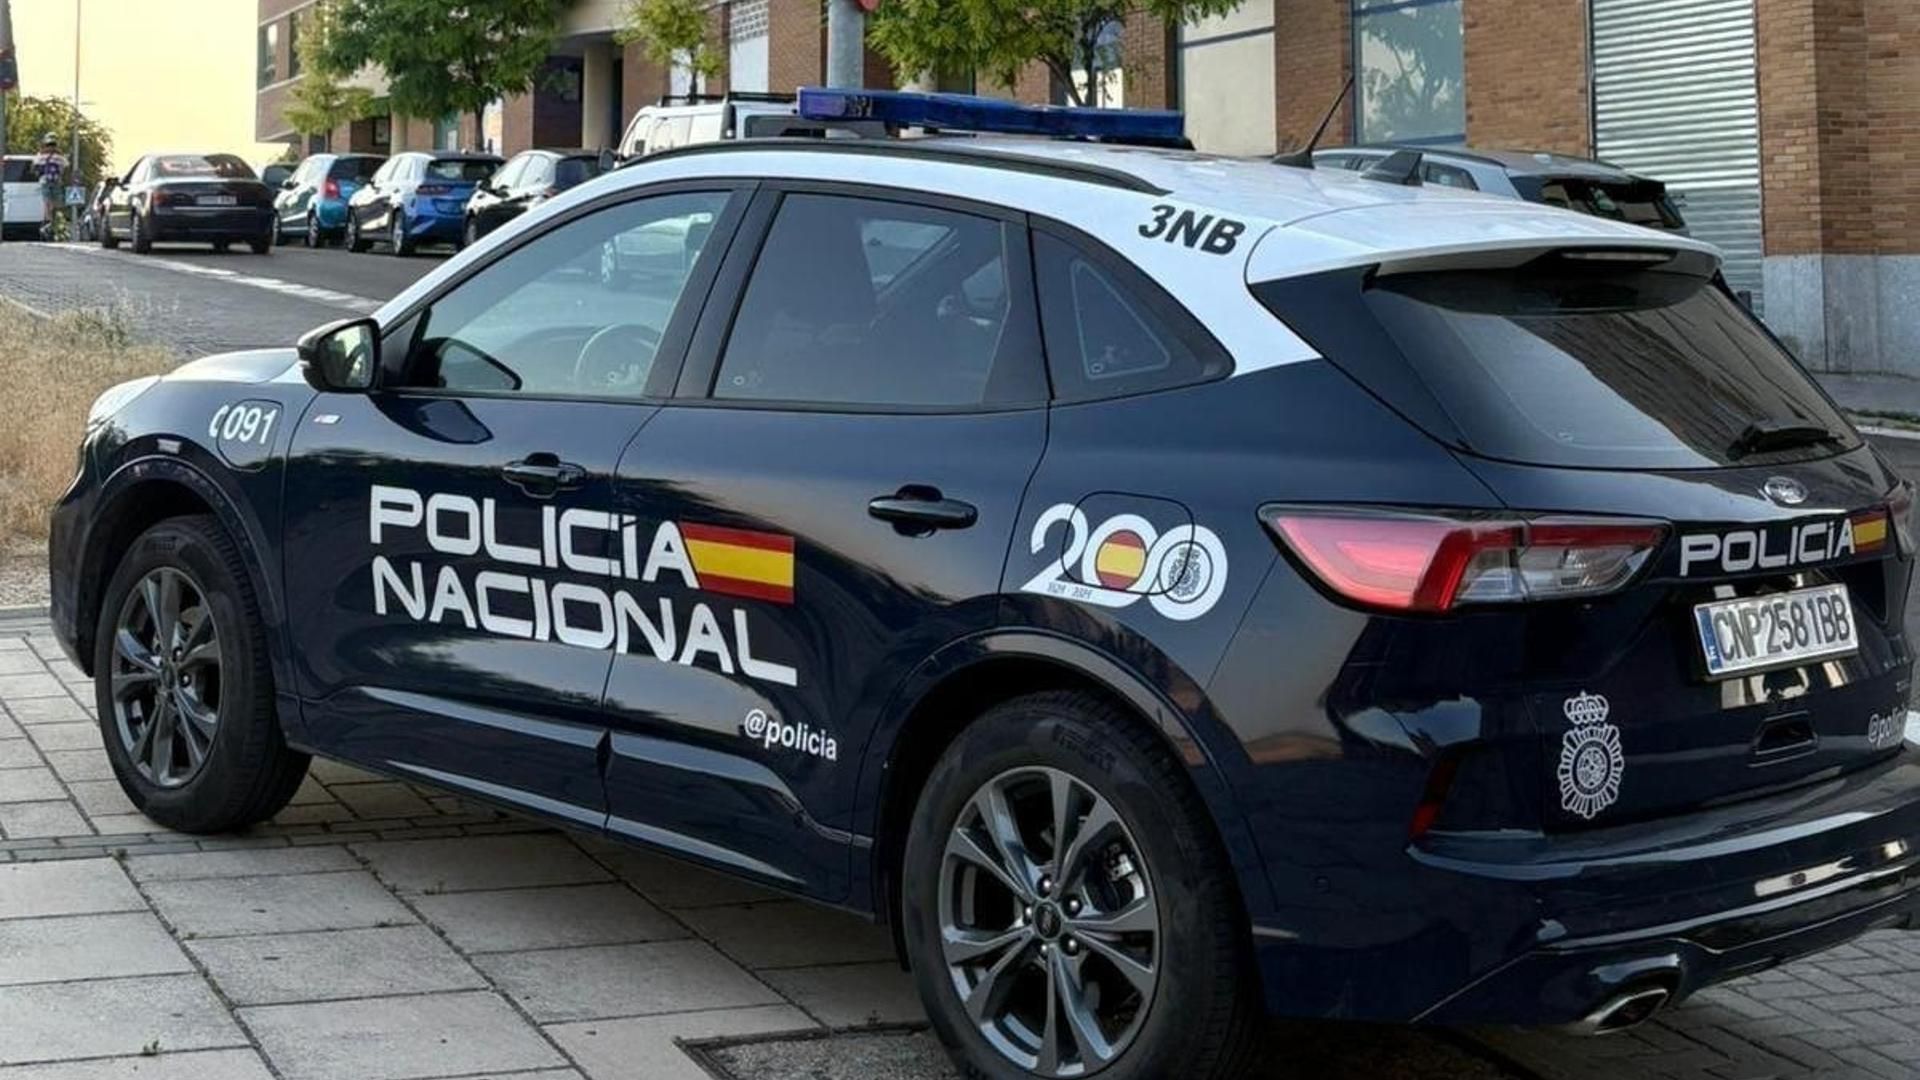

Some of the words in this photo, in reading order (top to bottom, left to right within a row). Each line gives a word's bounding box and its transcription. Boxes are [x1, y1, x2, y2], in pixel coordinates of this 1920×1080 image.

[1138, 205, 1246, 255] 3NB
[223, 406, 277, 444] 091
[373, 556, 797, 686] NACIONAL
[744, 709, 837, 761] @policia
